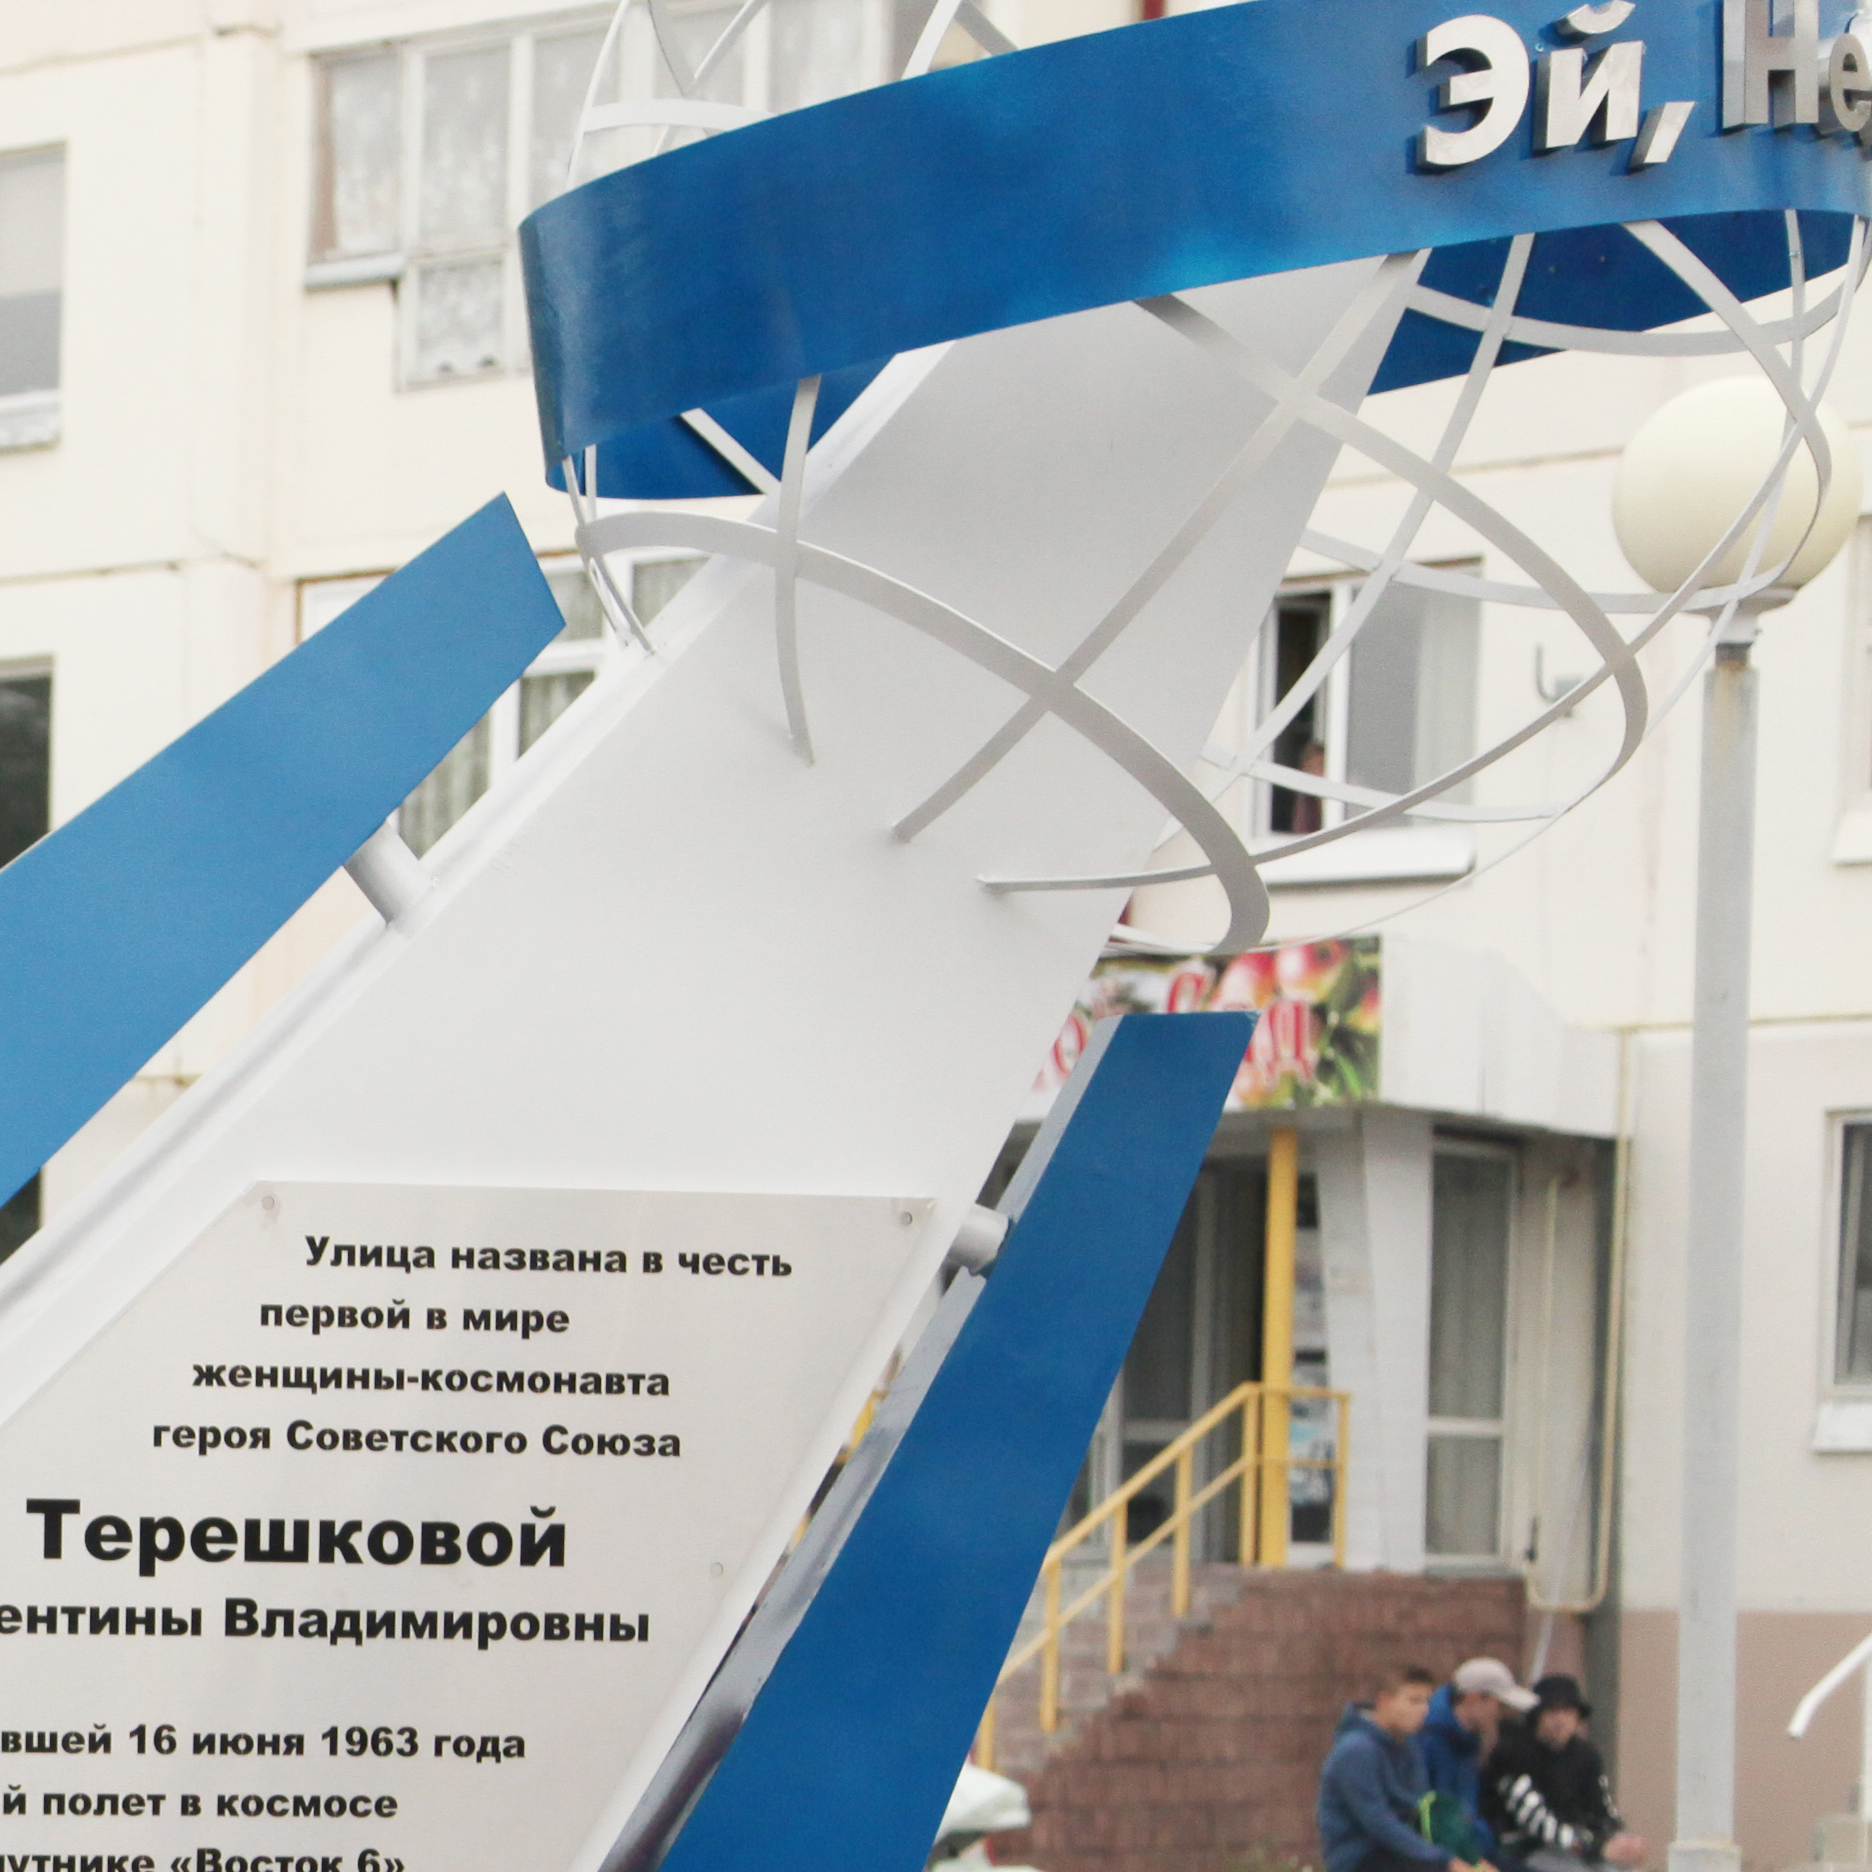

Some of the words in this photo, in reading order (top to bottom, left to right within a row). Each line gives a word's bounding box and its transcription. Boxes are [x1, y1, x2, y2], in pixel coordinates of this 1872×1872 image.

[1419, 0, 1696, 167] Эй,
[304, 1235, 436, 1275] Улица
[450, 1246, 628, 1274] названа
[641, 1250, 664, 1275] в
[677, 1251, 793, 1278] честь
[259, 1298, 411, 1337] первой
[425, 1307, 448, 1331] в
[461, 1308, 571, 1341] мире
[191, 1363, 670, 1397] женщины-космонавта
[152, 1424, 272, 1457] героя
[285, 1418, 529, 1455] Советского
[541, 1423, 682, 1458] Союза
[25, 1497, 567, 1579] Терешковой
[223, 1596, 650, 1651] Владимировны
[128, 1723, 178, 1756] 16
[191, 1732, 306, 1757] июня
[320, 1725, 420, 1759] 1963
[433, 1734, 526, 1765] года
[42, 1792, 167, 1818] полет
[179, 1793, 203, 1818] в
[215, 1793, 399, 1819] космосе
